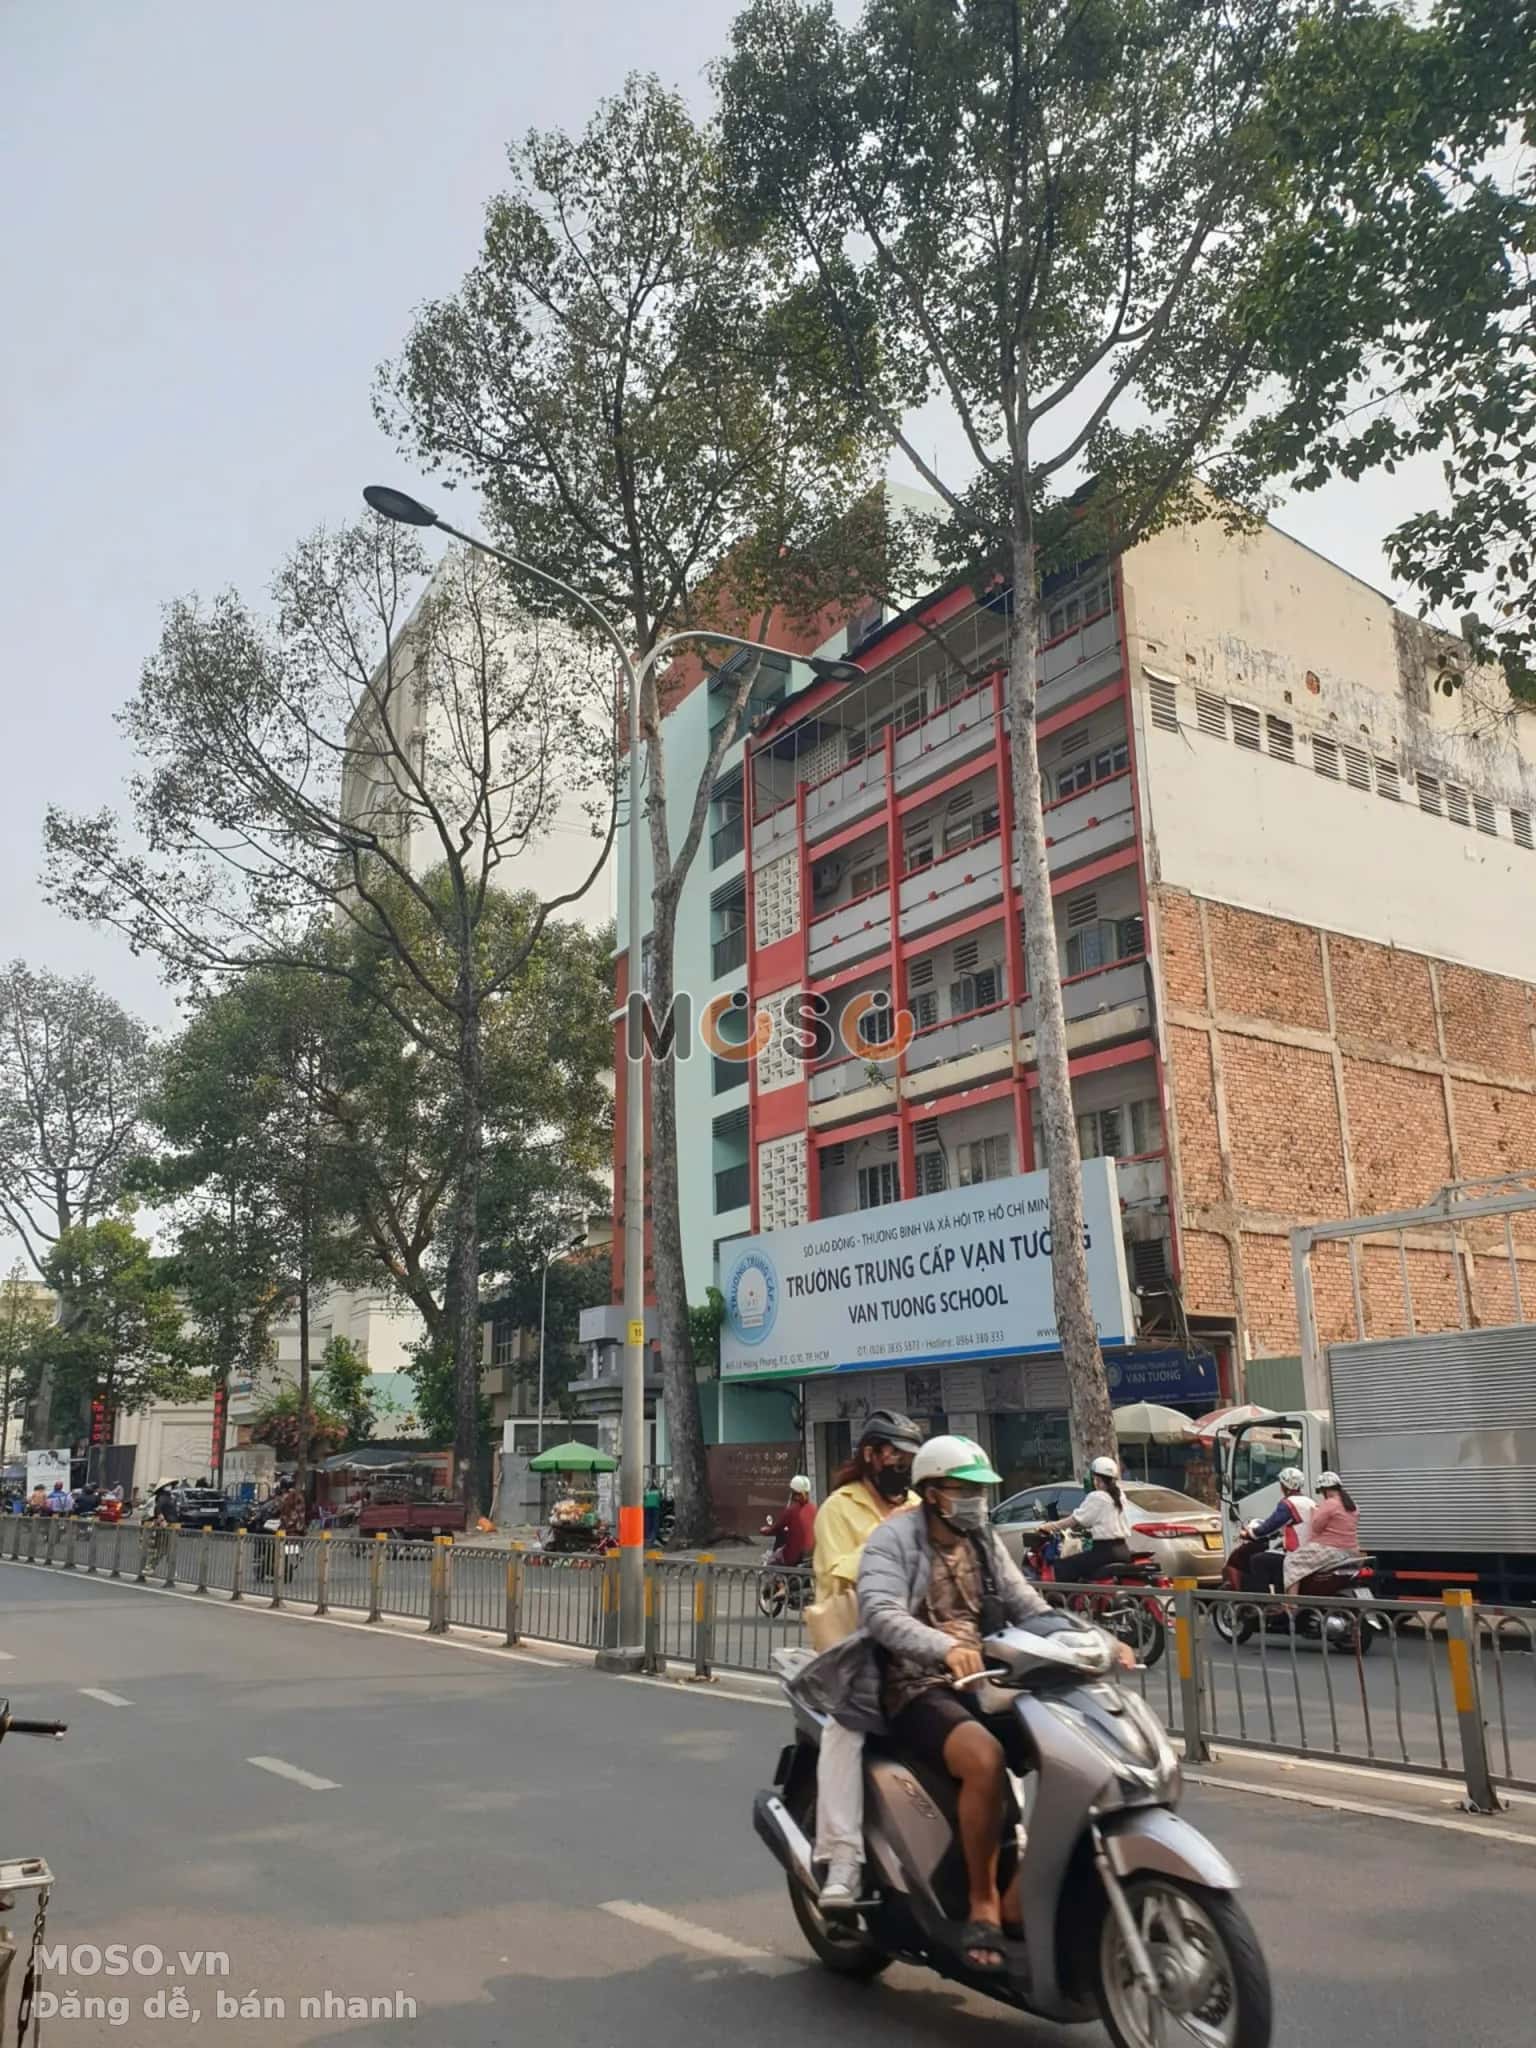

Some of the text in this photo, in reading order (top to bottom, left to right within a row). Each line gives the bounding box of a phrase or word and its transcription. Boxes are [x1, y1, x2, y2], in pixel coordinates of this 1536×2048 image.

[815, 1241, 831, 1255] LAO
[900, 1223, 922, 1239] BINH
[953, 1212, 971, 1228] HỘI
[988, 1203, 1004, 1222] HỒ
[1006, 1201, 1025, 1217] CHÍ
[1027, 1197, 1050, 1213] MIN
[787, 1263, 851, 1298] TRƯỜNG
[855, 1255, 915, 1287] TRUNG
[919, 1243, 956, 1275] CẤP
[960, 1238, 1006, 1273] VẠN
[848, 1283, 1009, 1325] VAN TUONG SCHOOL
